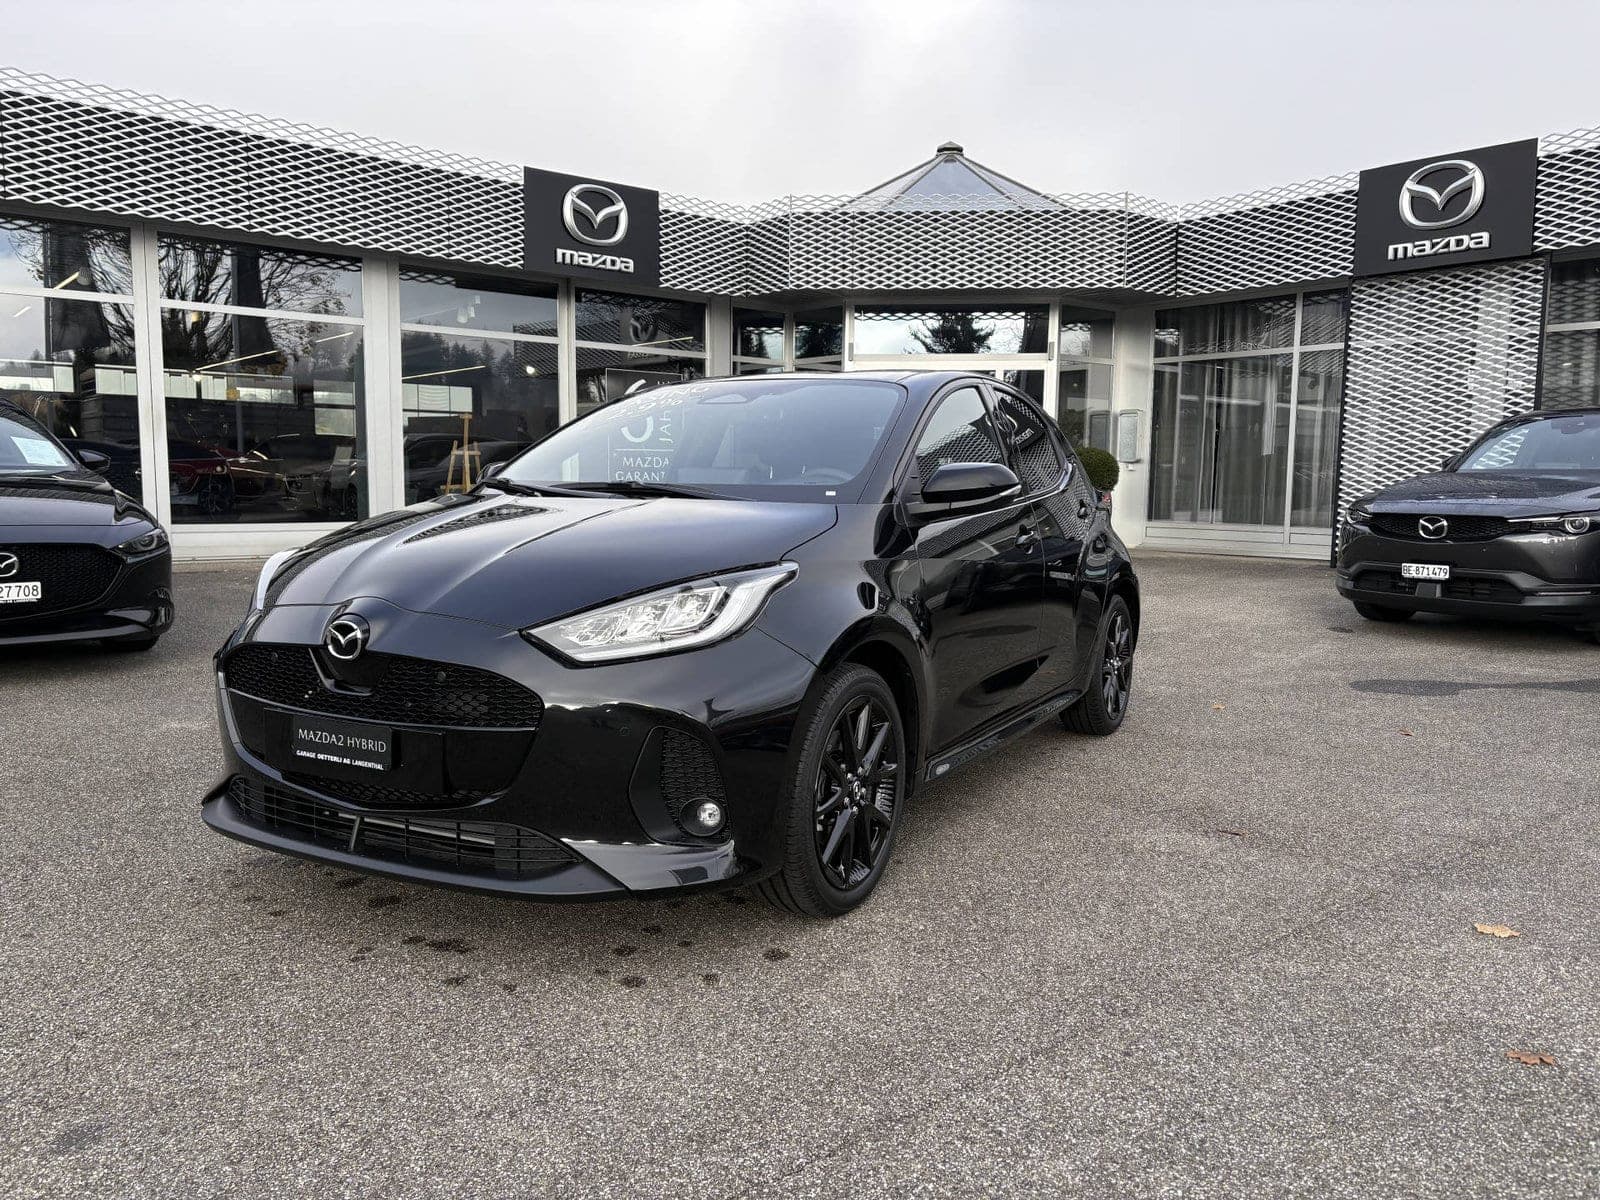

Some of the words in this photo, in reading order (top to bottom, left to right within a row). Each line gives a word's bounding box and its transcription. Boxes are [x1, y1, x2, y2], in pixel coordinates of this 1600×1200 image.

[622, 457, 670, 469] MAZDA
[615, 471, 666, 481] GARANT
[298, 728, 345, 746] MAZDA2
[347, 736, 387, 753] HYBRID
[296, 749, 316, 759] GARAGE
[352, 759, 384, 770] LANGENTHAL
